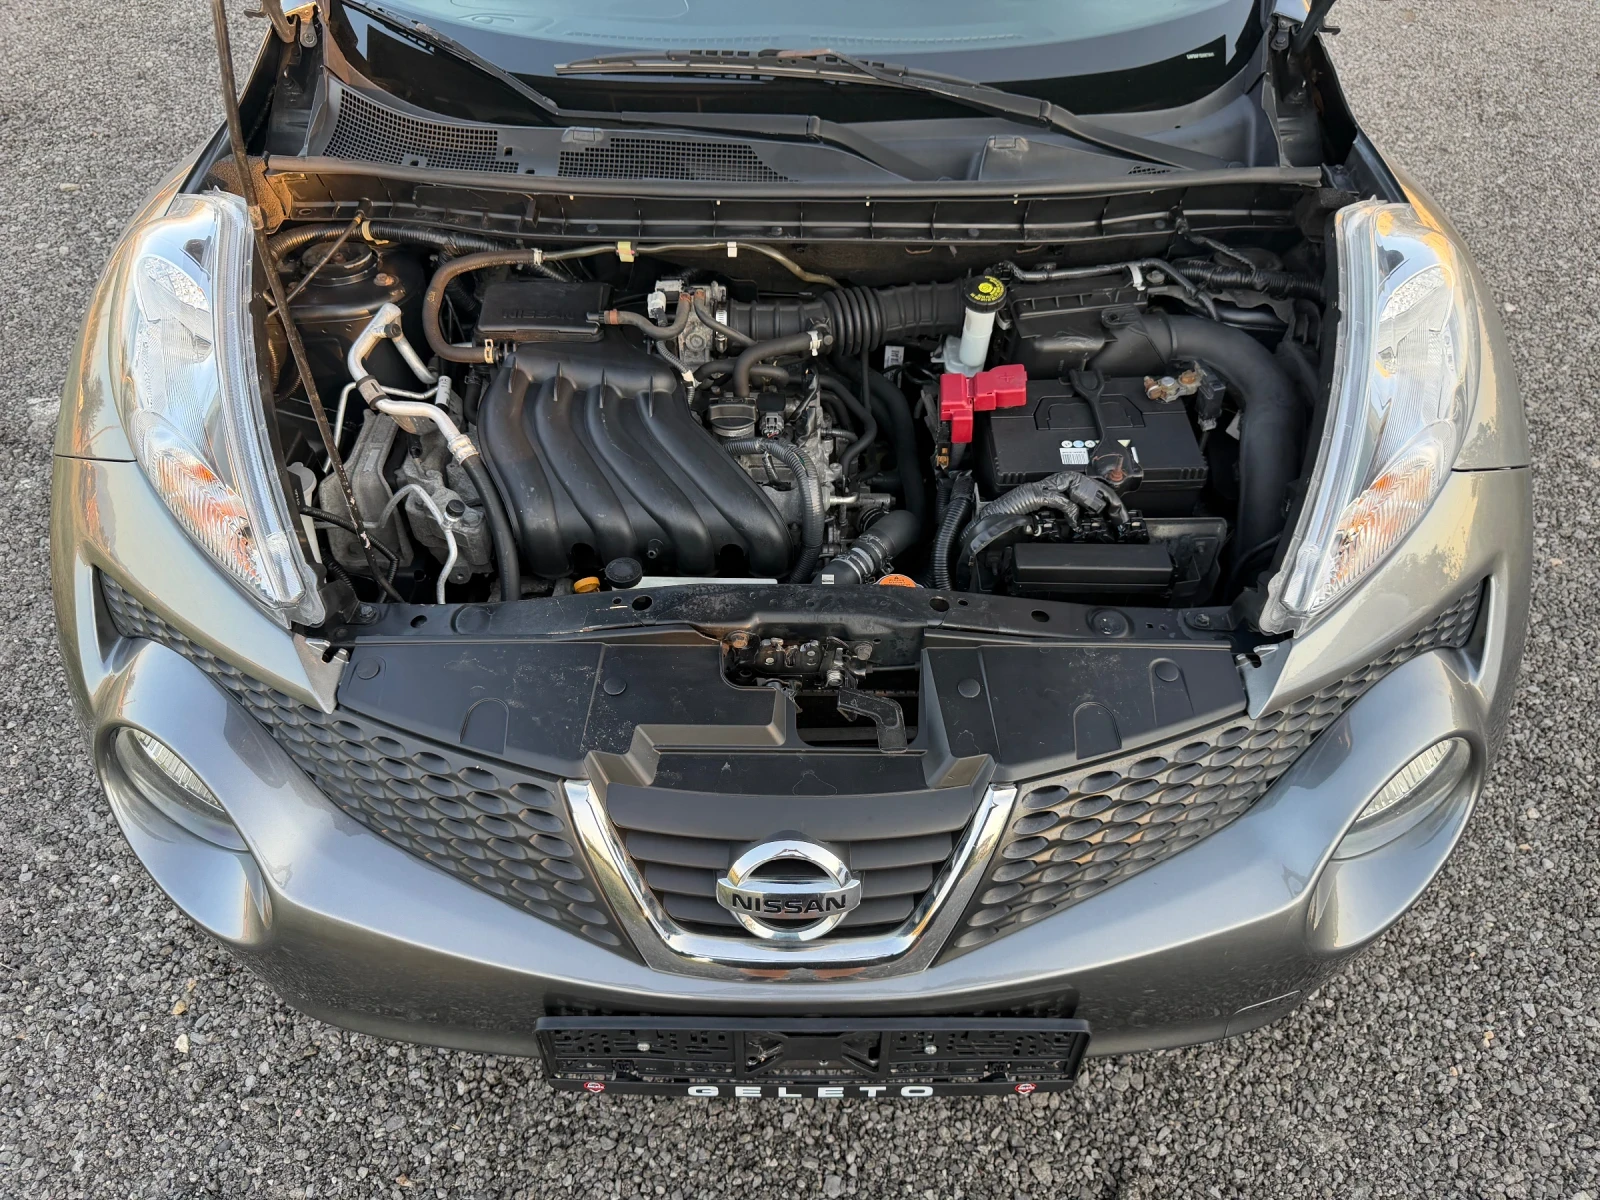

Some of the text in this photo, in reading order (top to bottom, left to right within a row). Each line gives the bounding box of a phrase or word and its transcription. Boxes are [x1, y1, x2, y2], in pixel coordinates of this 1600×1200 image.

[501, 308, 576, 320] NISSAN
[731, 893, 847, 914] NISSAN
[687, 1085, 935, 1098] GELETO
